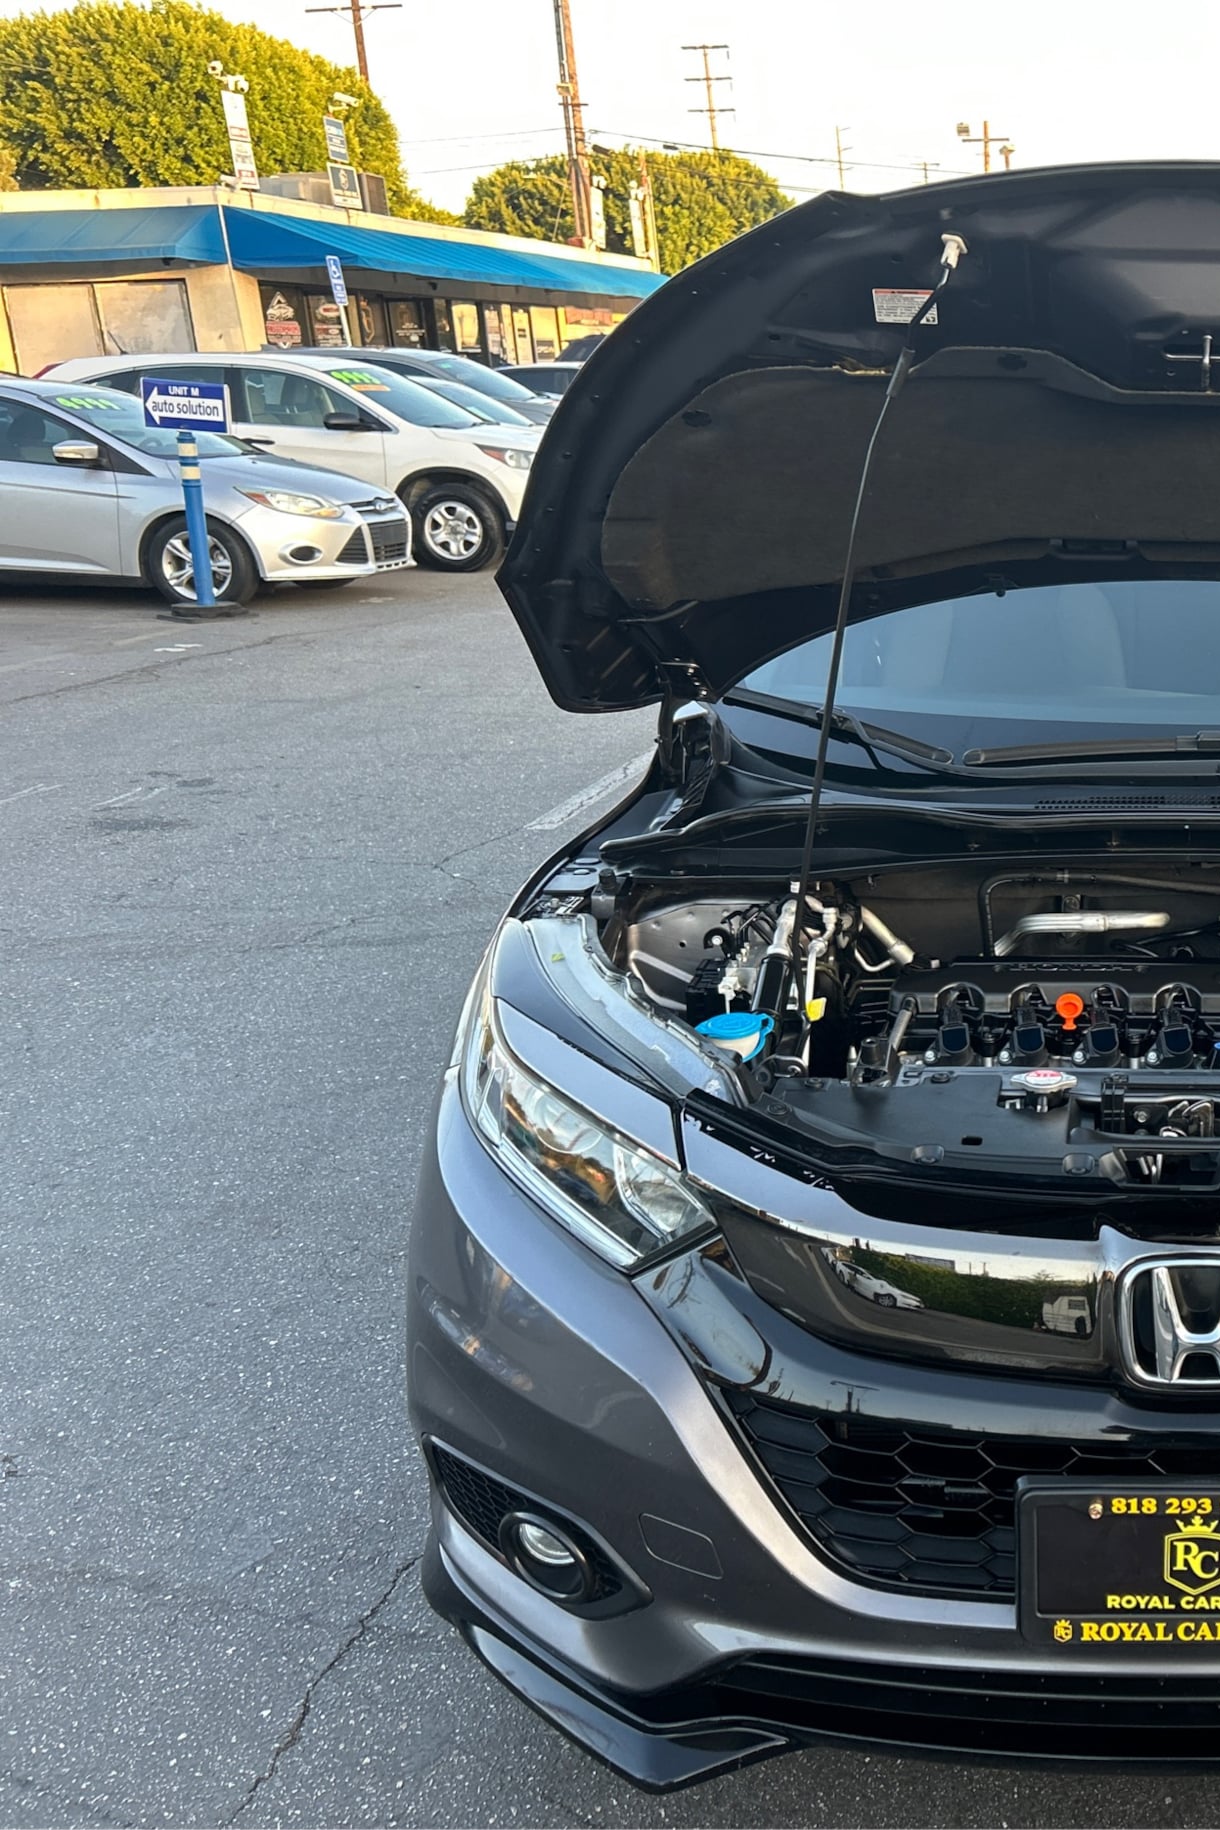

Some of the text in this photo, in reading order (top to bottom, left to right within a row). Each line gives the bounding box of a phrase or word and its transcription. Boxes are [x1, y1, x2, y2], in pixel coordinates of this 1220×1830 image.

[168, 386, 200, 397] UNIT M
[151, 401, 219, 417] auto solution
[1111, 1498, 1158, 1514] 818
[1165, 1498, 1213, 1514] 293
[1172, 1541, 1220, 1579] RC
[1106, 1595, 1176, 1609] ROYAL
[1080, 1622, 1174, 1641] ROYAL
